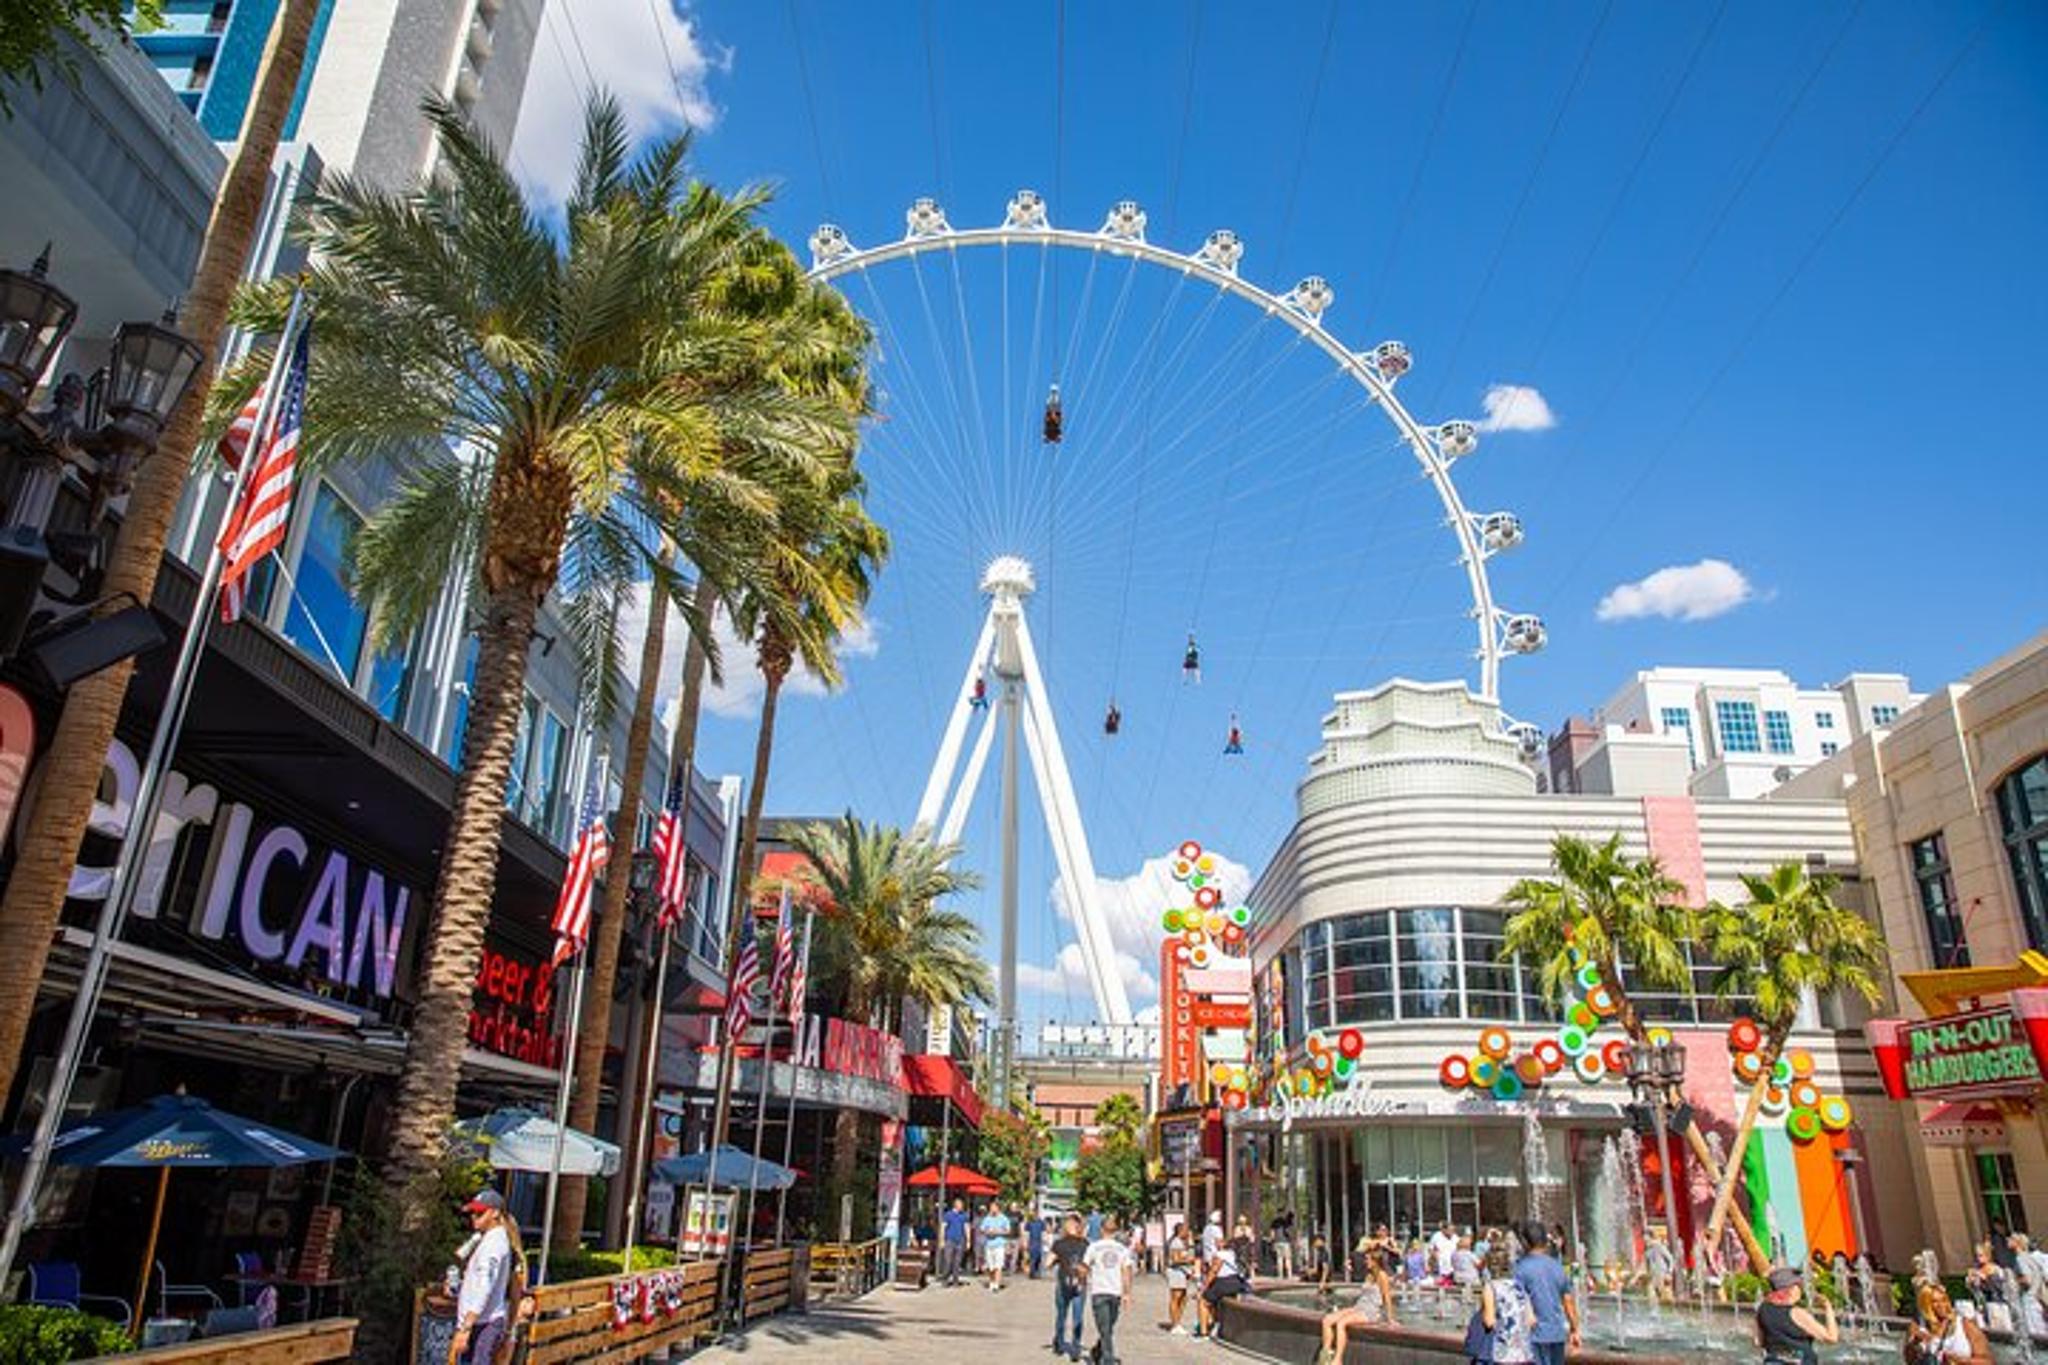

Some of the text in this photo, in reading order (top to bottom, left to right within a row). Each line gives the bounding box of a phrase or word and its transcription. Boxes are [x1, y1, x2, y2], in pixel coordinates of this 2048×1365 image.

[12, 735, 411, 997] erICAN
[1911, 1014, 2012, 1055] IN-N-OUT
[1904, 1043, 2040, 1091] HAMBURGERS
